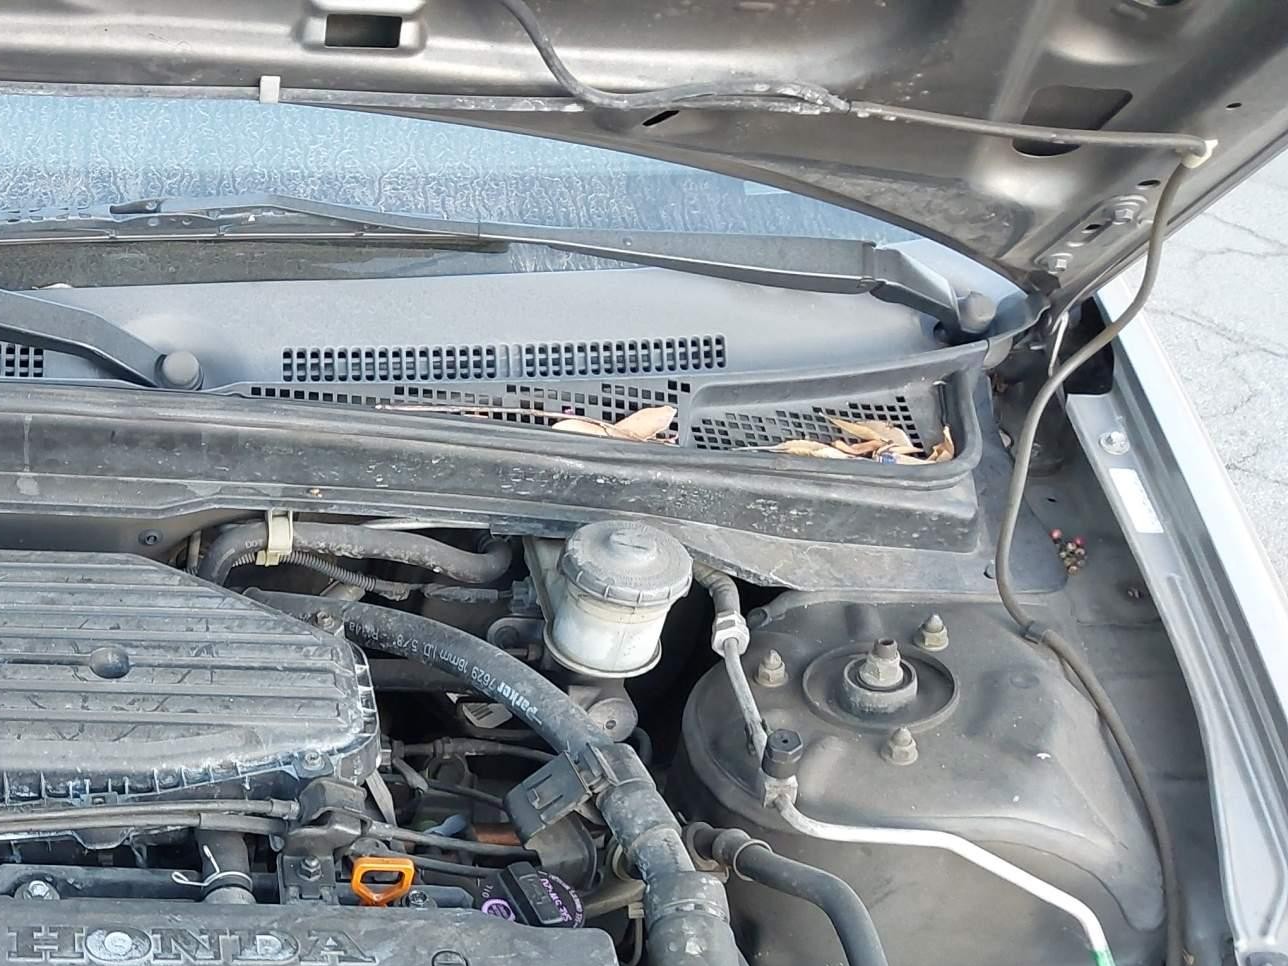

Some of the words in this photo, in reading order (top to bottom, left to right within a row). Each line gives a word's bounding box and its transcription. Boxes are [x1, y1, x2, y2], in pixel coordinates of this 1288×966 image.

[468, 665, 497, 689] 7629
[496, 680, 540, 726] Parker
[6, 925, 377, 965] HONDA
